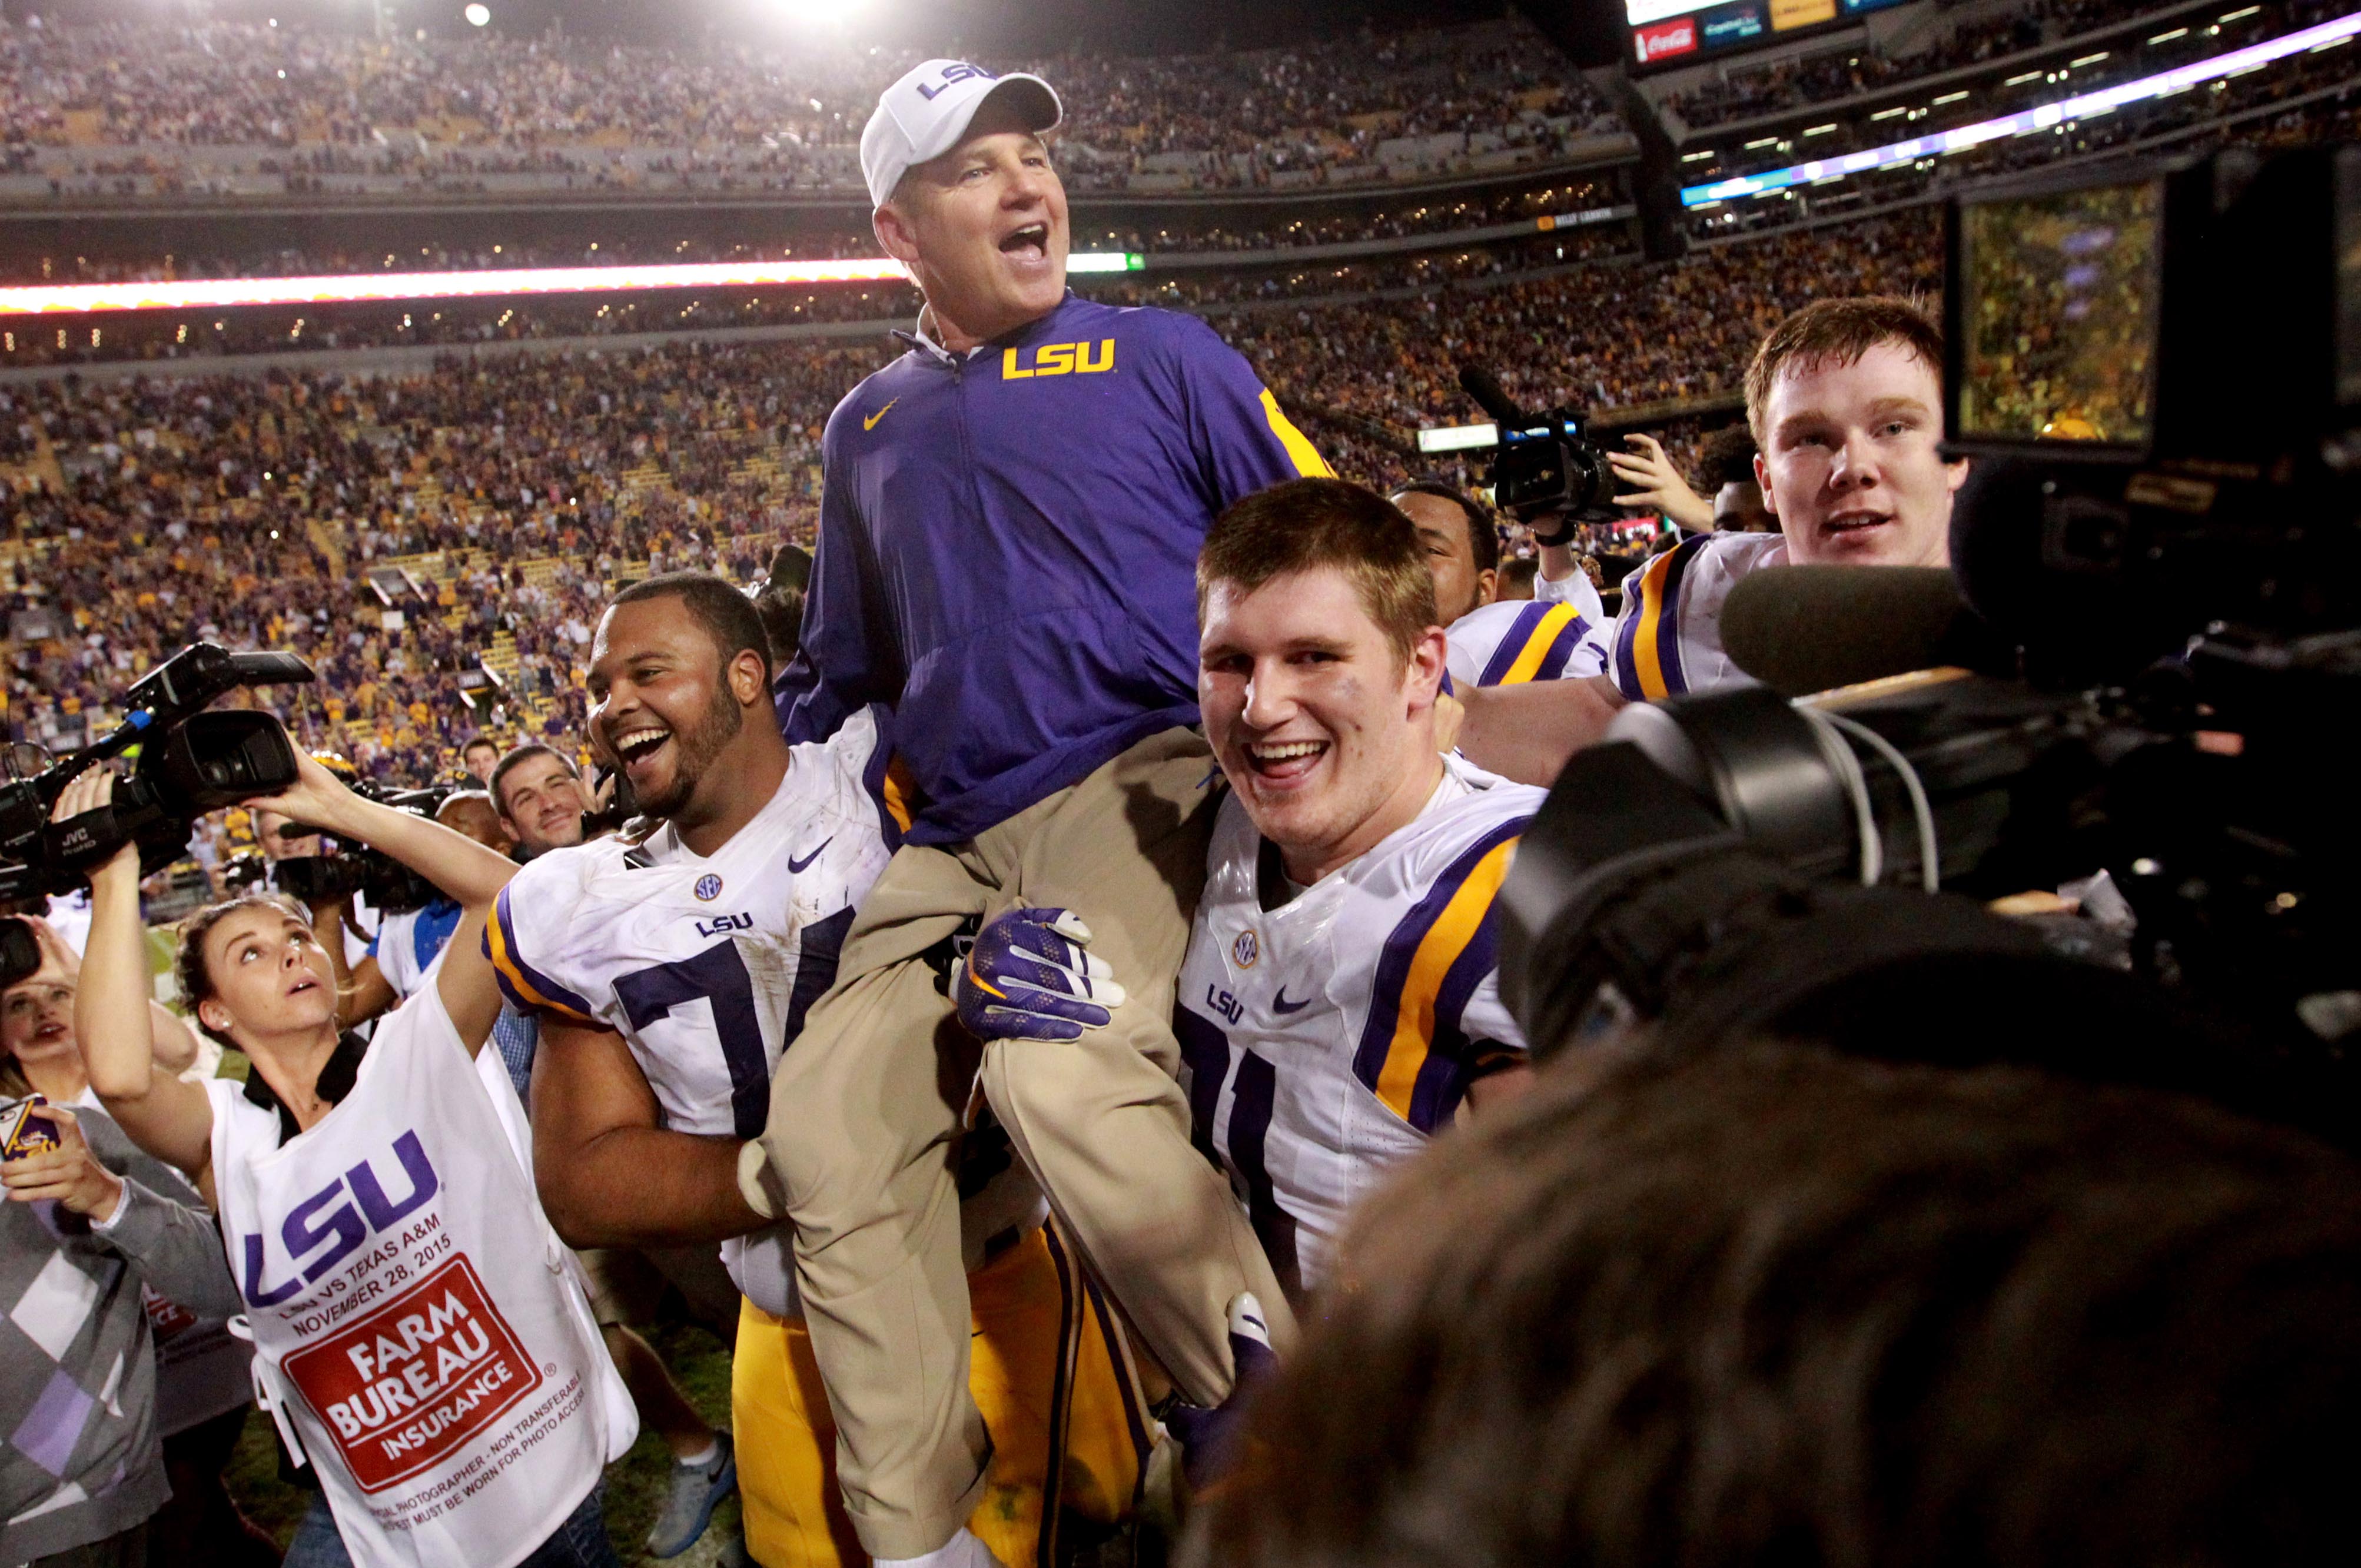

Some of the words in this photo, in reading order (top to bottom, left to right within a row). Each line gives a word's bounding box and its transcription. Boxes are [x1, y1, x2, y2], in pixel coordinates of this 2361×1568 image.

[916, 64, 999, 101] LSU
[1002, 338, 1115, 380] LSU
[62, 828, 88, 846] JVC
[695, 912, 753, 938] LSU
[1206, 983, 1244, 1026] LSU
[244, 1129, 438, 1308] LSU
[318, 1278, 347, 1298] VS
[345, 1241, 399, 1283] TEXAS
[402, 1213, 441, 1248] A&M
[293, 1280, 384, 1337] NOVEMBER
[386, 1264, 416, 1289] 28,
[417, 1234, 453, 1268] 2015
[347, 1288, 469, 1383] FARM
[326, 1317, 491, 1440] BUREAU
[380, 1359, 513, 1461] INSURANCE
[396, 1455, 486, 1513] PHOTOGRAPHER
[490, 1431, 515, 1455] NON
[413, 1503, 443, 1526] MUST
[444, 1493, 464, 1510] BE
[462, 1466, 499, 1499] WORN
[497, 1447, 522, 1471] FOR
[520, 1418, 557, 1452] PHOTO
